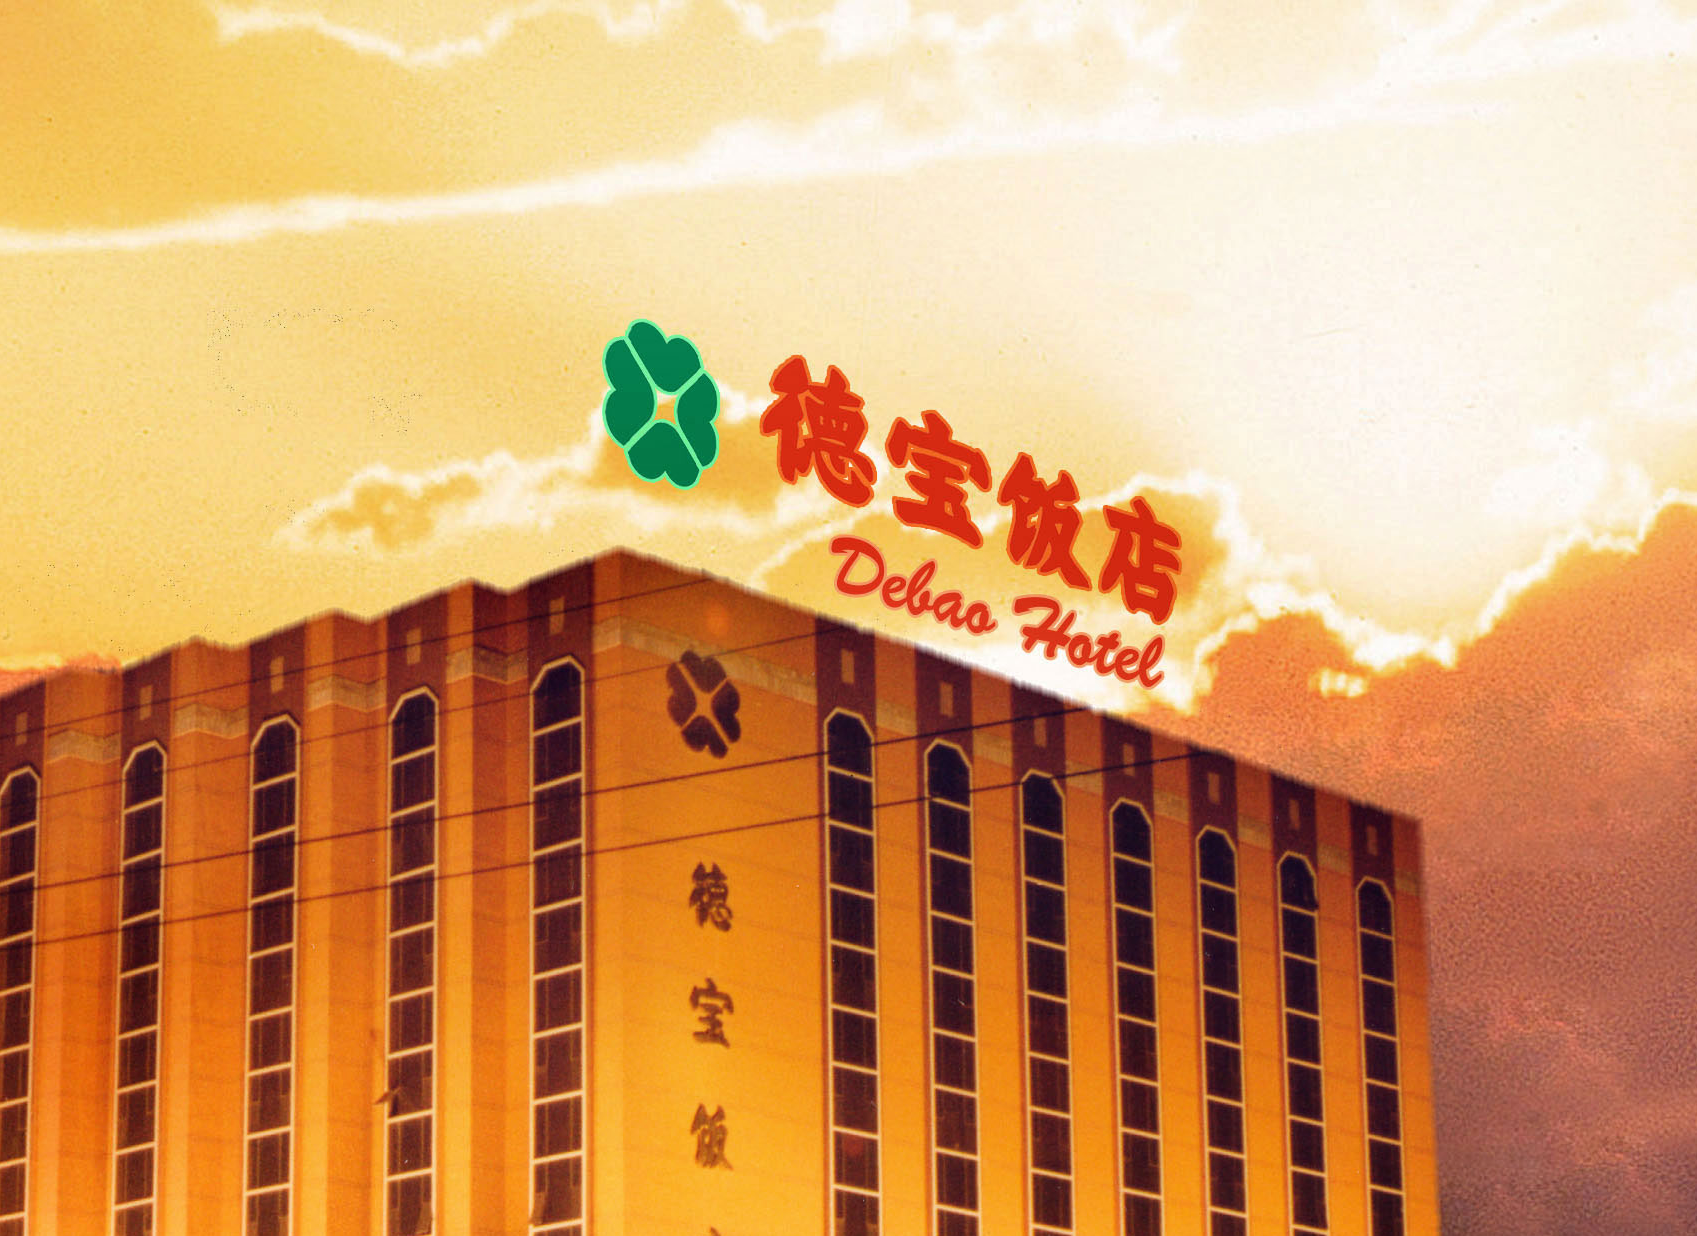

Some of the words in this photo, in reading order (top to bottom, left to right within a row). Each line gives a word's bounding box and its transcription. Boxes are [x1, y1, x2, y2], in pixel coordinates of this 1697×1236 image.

[760, 355, 1182, 624] 德宝饭店
[829, 535, 997, 636] Debao
[1011, 595, 1164, 688] Hotel
